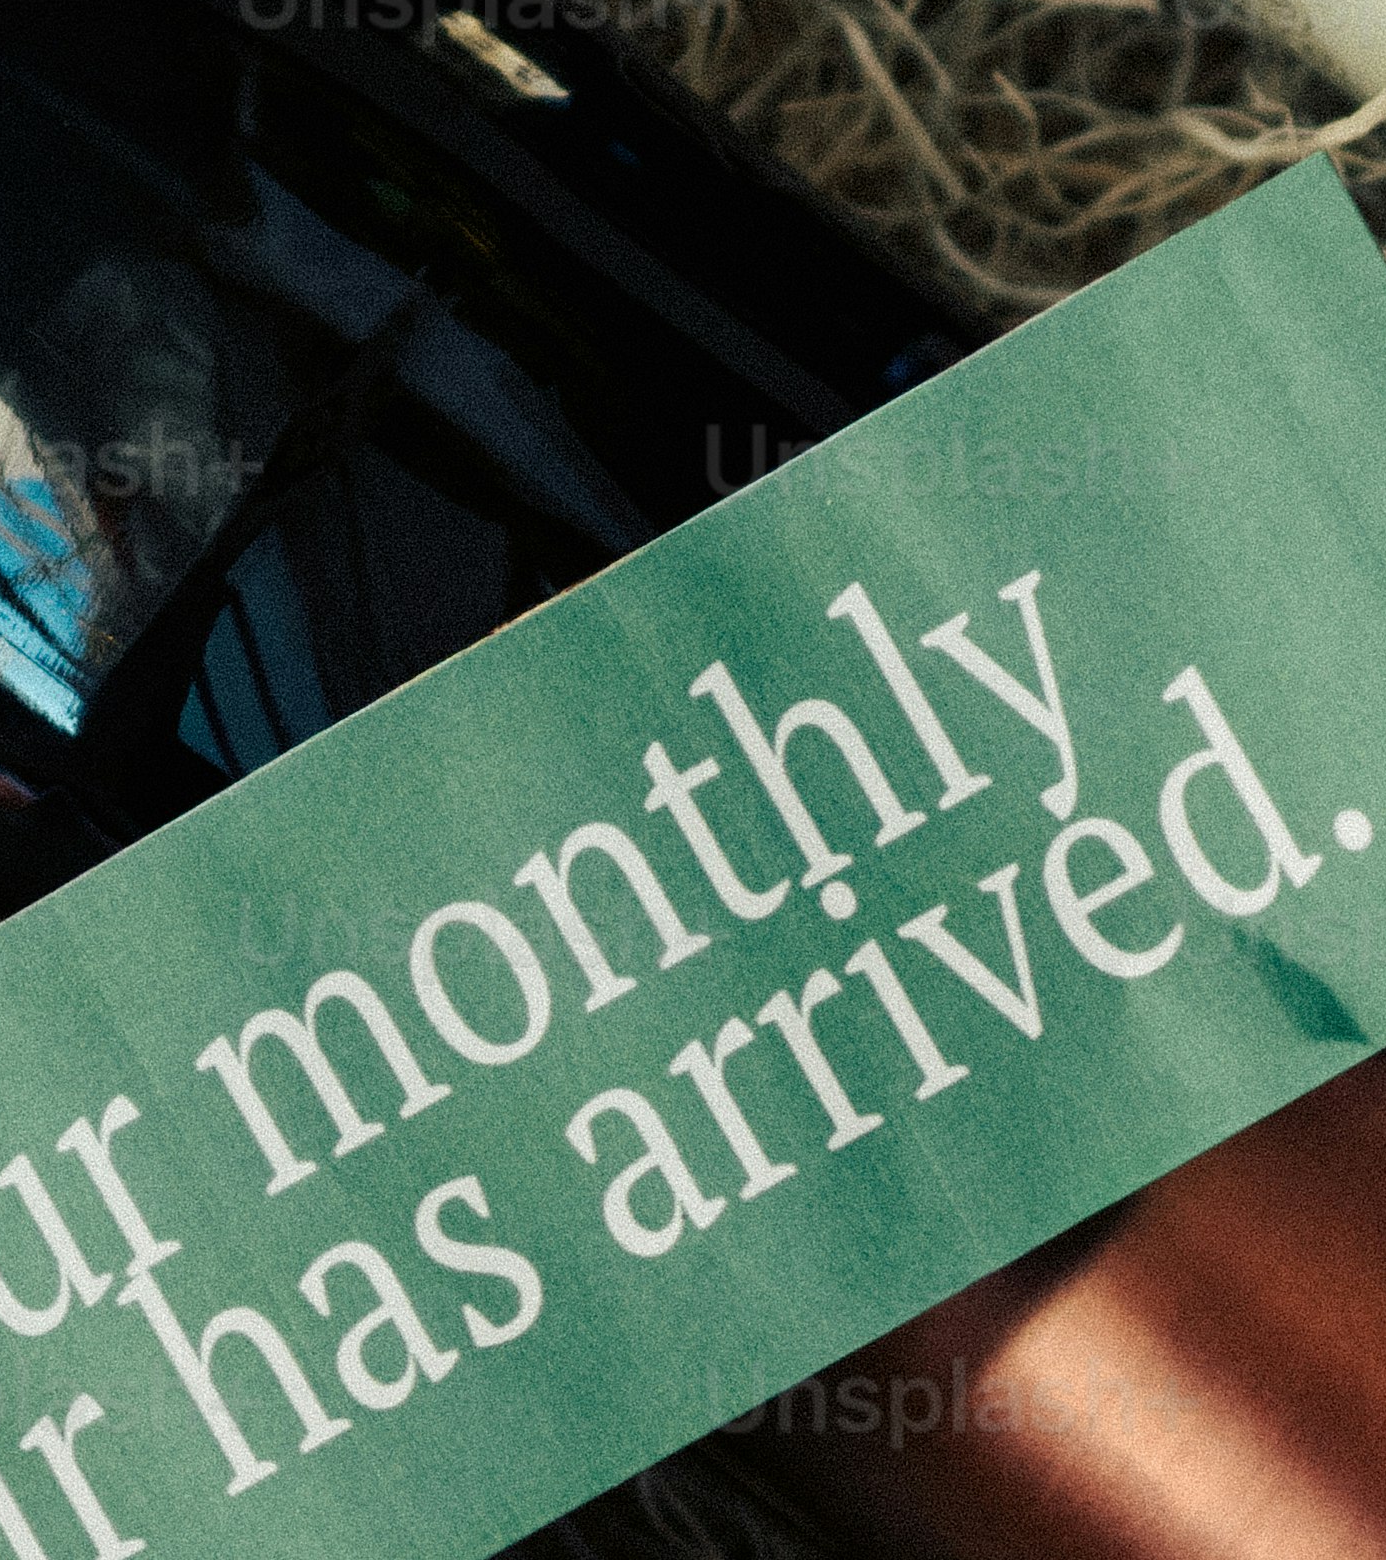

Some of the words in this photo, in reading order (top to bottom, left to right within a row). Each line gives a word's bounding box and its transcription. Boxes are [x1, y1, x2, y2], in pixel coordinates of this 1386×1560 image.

[116, 1174, 545, 1498] has
[563, 664, 1374, 1258] arrived.
[195, 569, 1080, 1198] monthly
